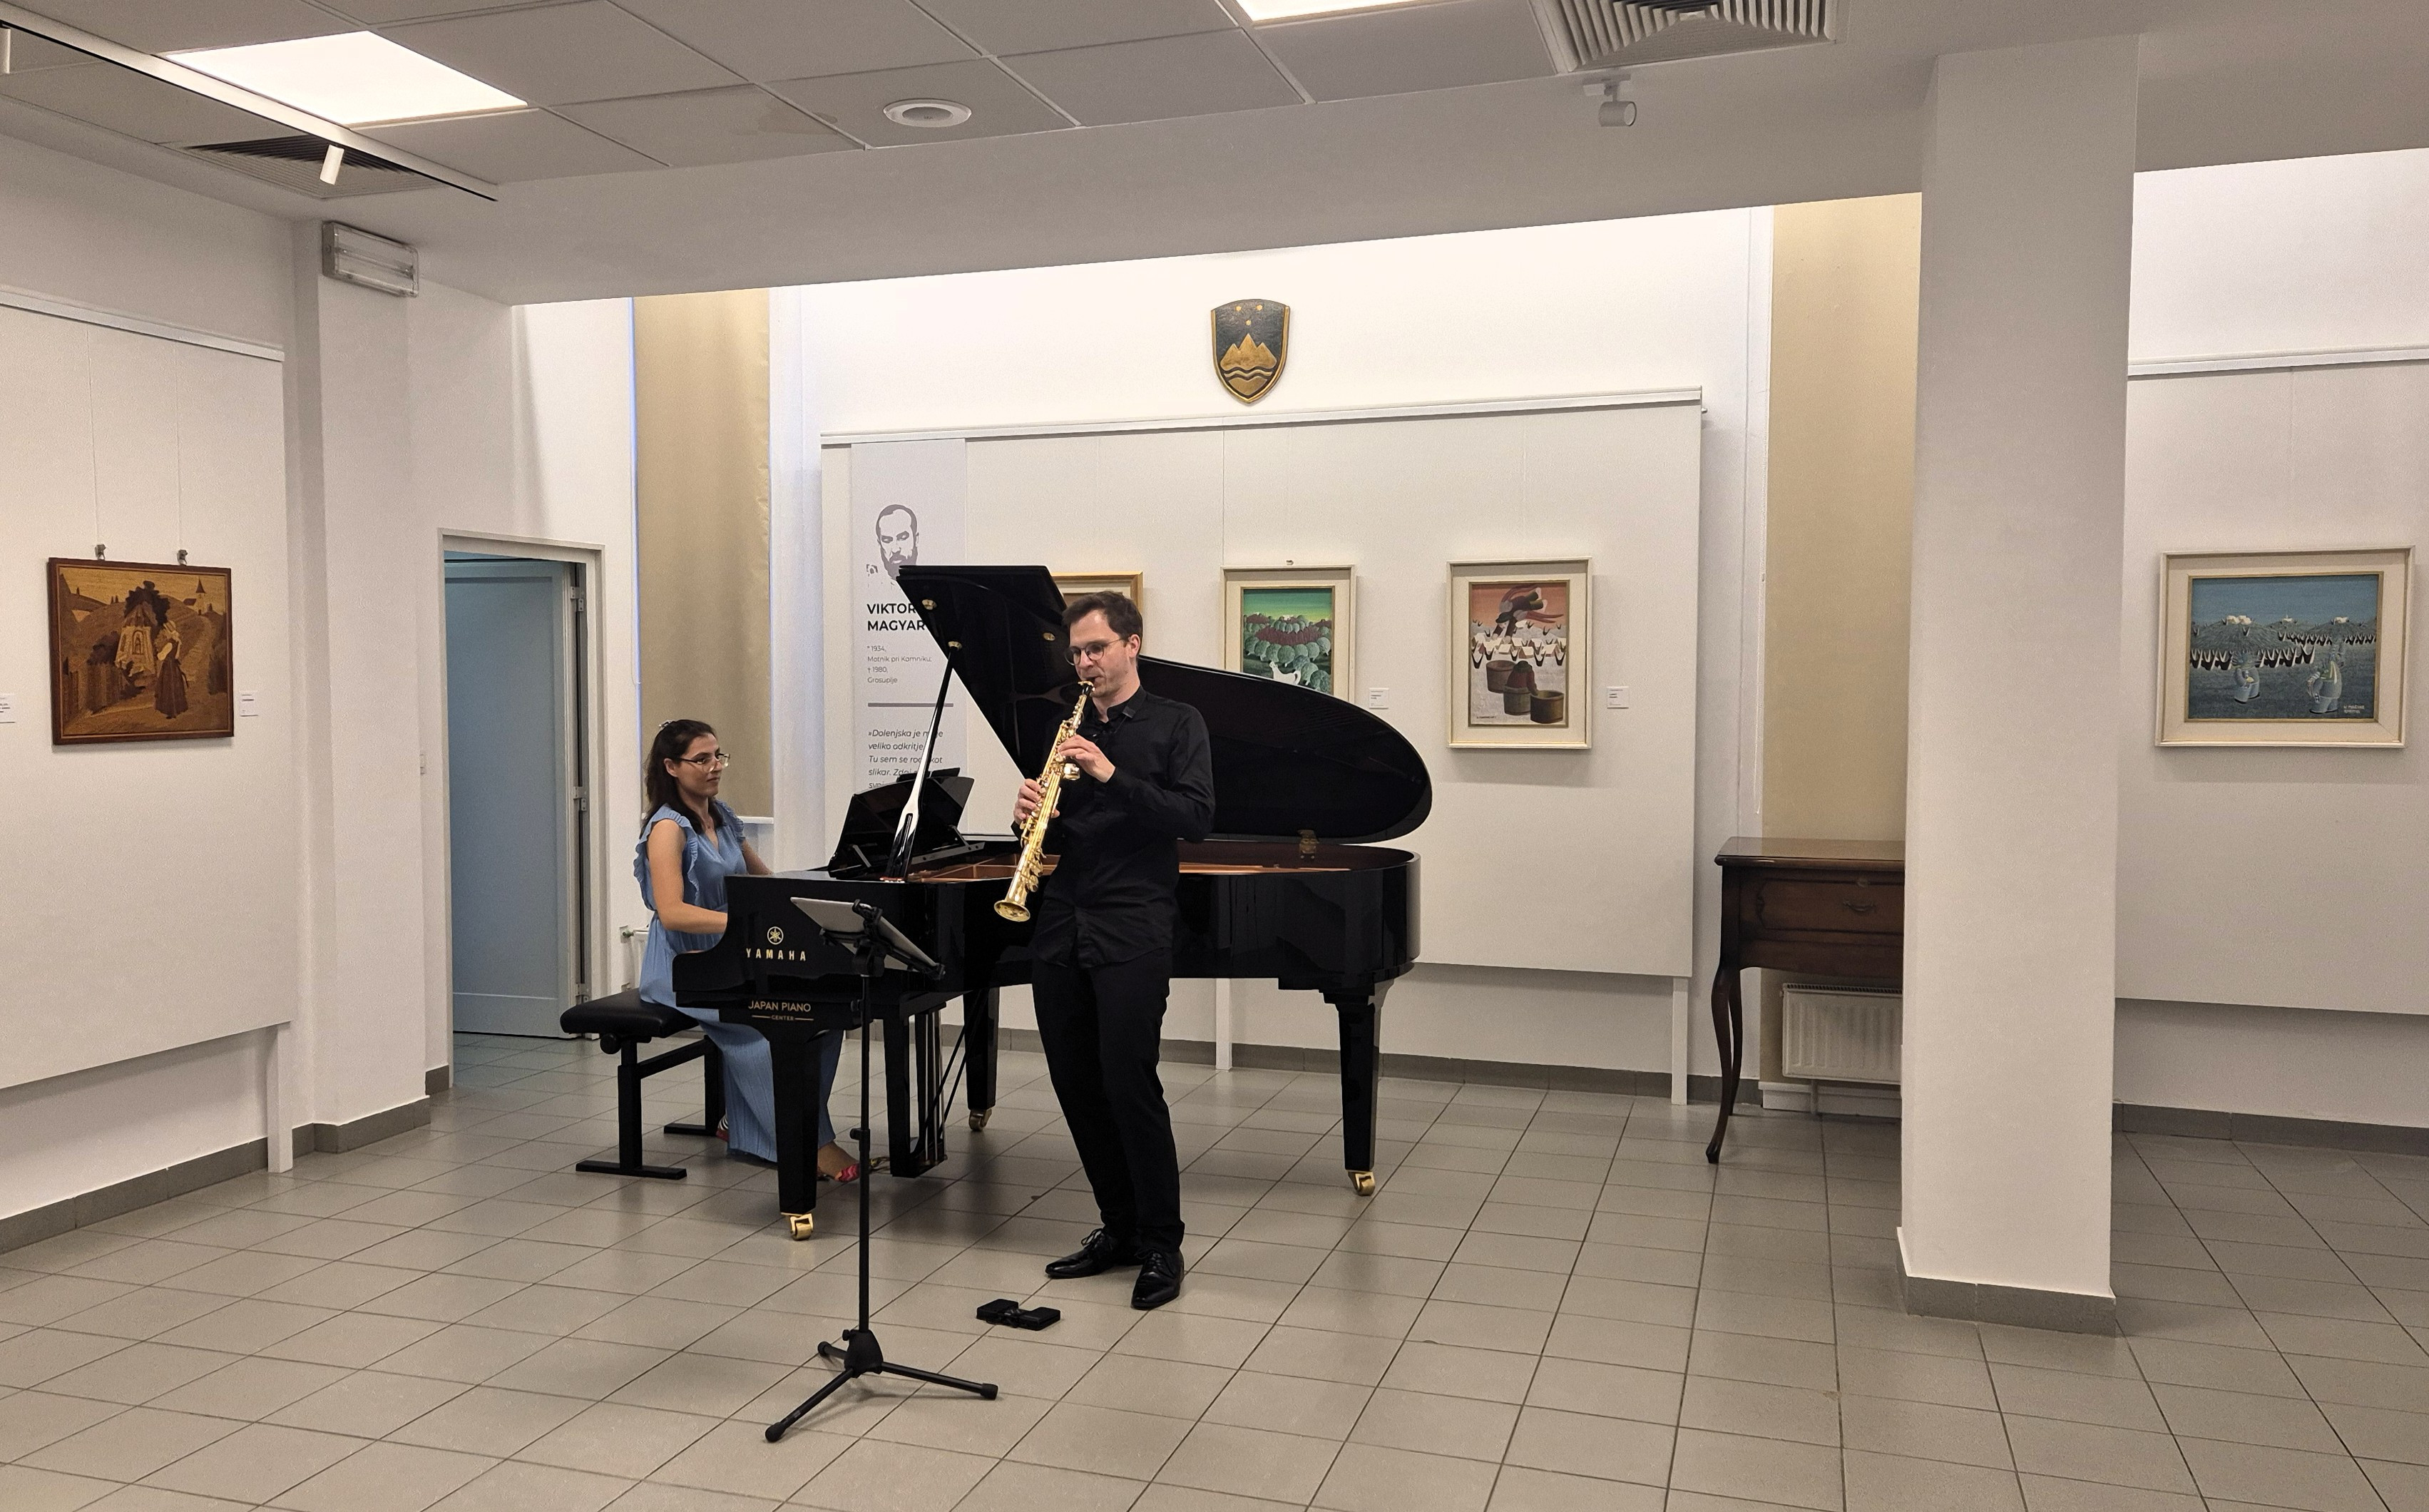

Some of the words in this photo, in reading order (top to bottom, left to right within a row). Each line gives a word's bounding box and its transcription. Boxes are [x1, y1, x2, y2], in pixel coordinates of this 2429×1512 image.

[866, 603, 916, 614] VIKTOR
[867, 620, 925, 631] MAGYAR
[891, 655, 900, 664] pri
[912, 729, 921, 738] je
[869, 742, 891, 750] veliko
[746, 948, 806, 961] YAMAHA
[748, 1001, 779, 1011] JAPAN
[781, 1002, 812, 1012] PIANO
